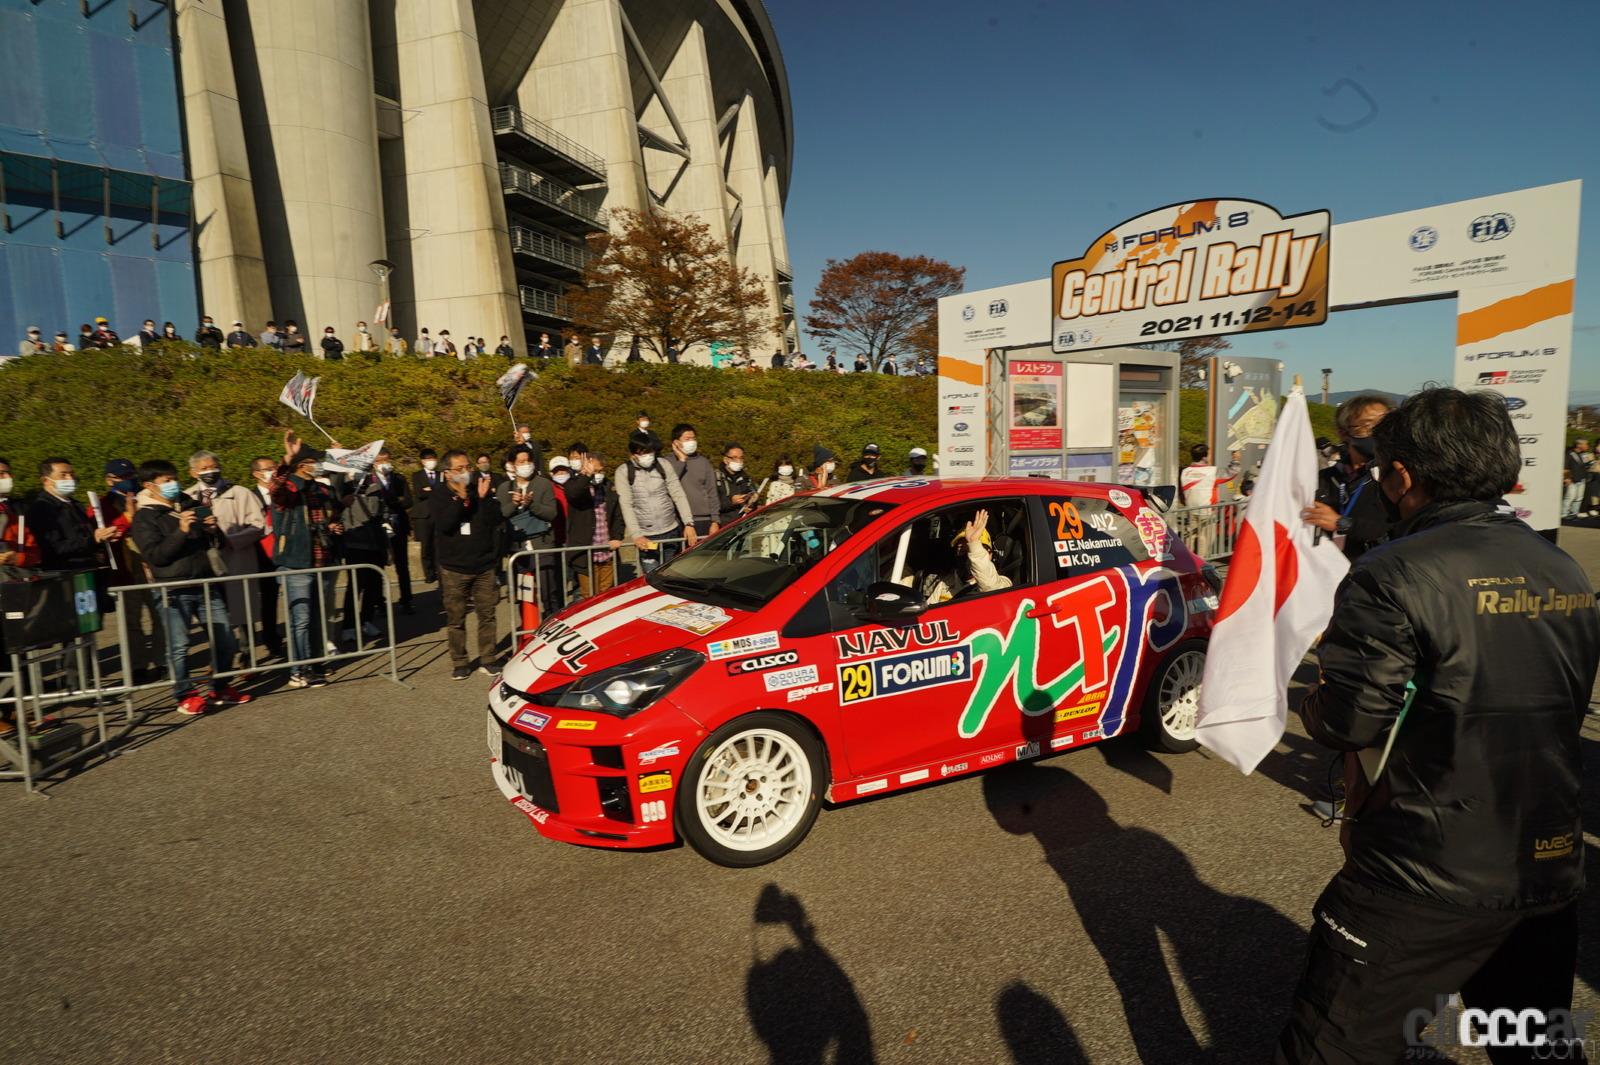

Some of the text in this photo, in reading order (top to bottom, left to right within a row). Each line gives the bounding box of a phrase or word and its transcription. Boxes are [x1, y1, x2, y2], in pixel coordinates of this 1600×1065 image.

[1122, 216, 1221, 250] FORUM
[1228, 212, 1249, 228] 8
[1059, 229, 1321, 320] Central Rally
[1139, 300, 1316, 336] 2021 11.12-14
[1016, 363, 1054, 374] レストラン
[1476, 349, 1540, 361] FORUM
[1049, 501, 1117, 539] 29 JN2
[1068, 538, 1122, 551] E.Nakamura
[1072, 554, 1101, 567] K.Oya
[1477, 587, 1596, 619] Rally Japan
[836, 620, 960, 659] NAVUL
[741, 652, 798, 671] CUSCO
[842, 664, 872, 701] 29
[1062, 706, 1097, 717] DUNLOP
